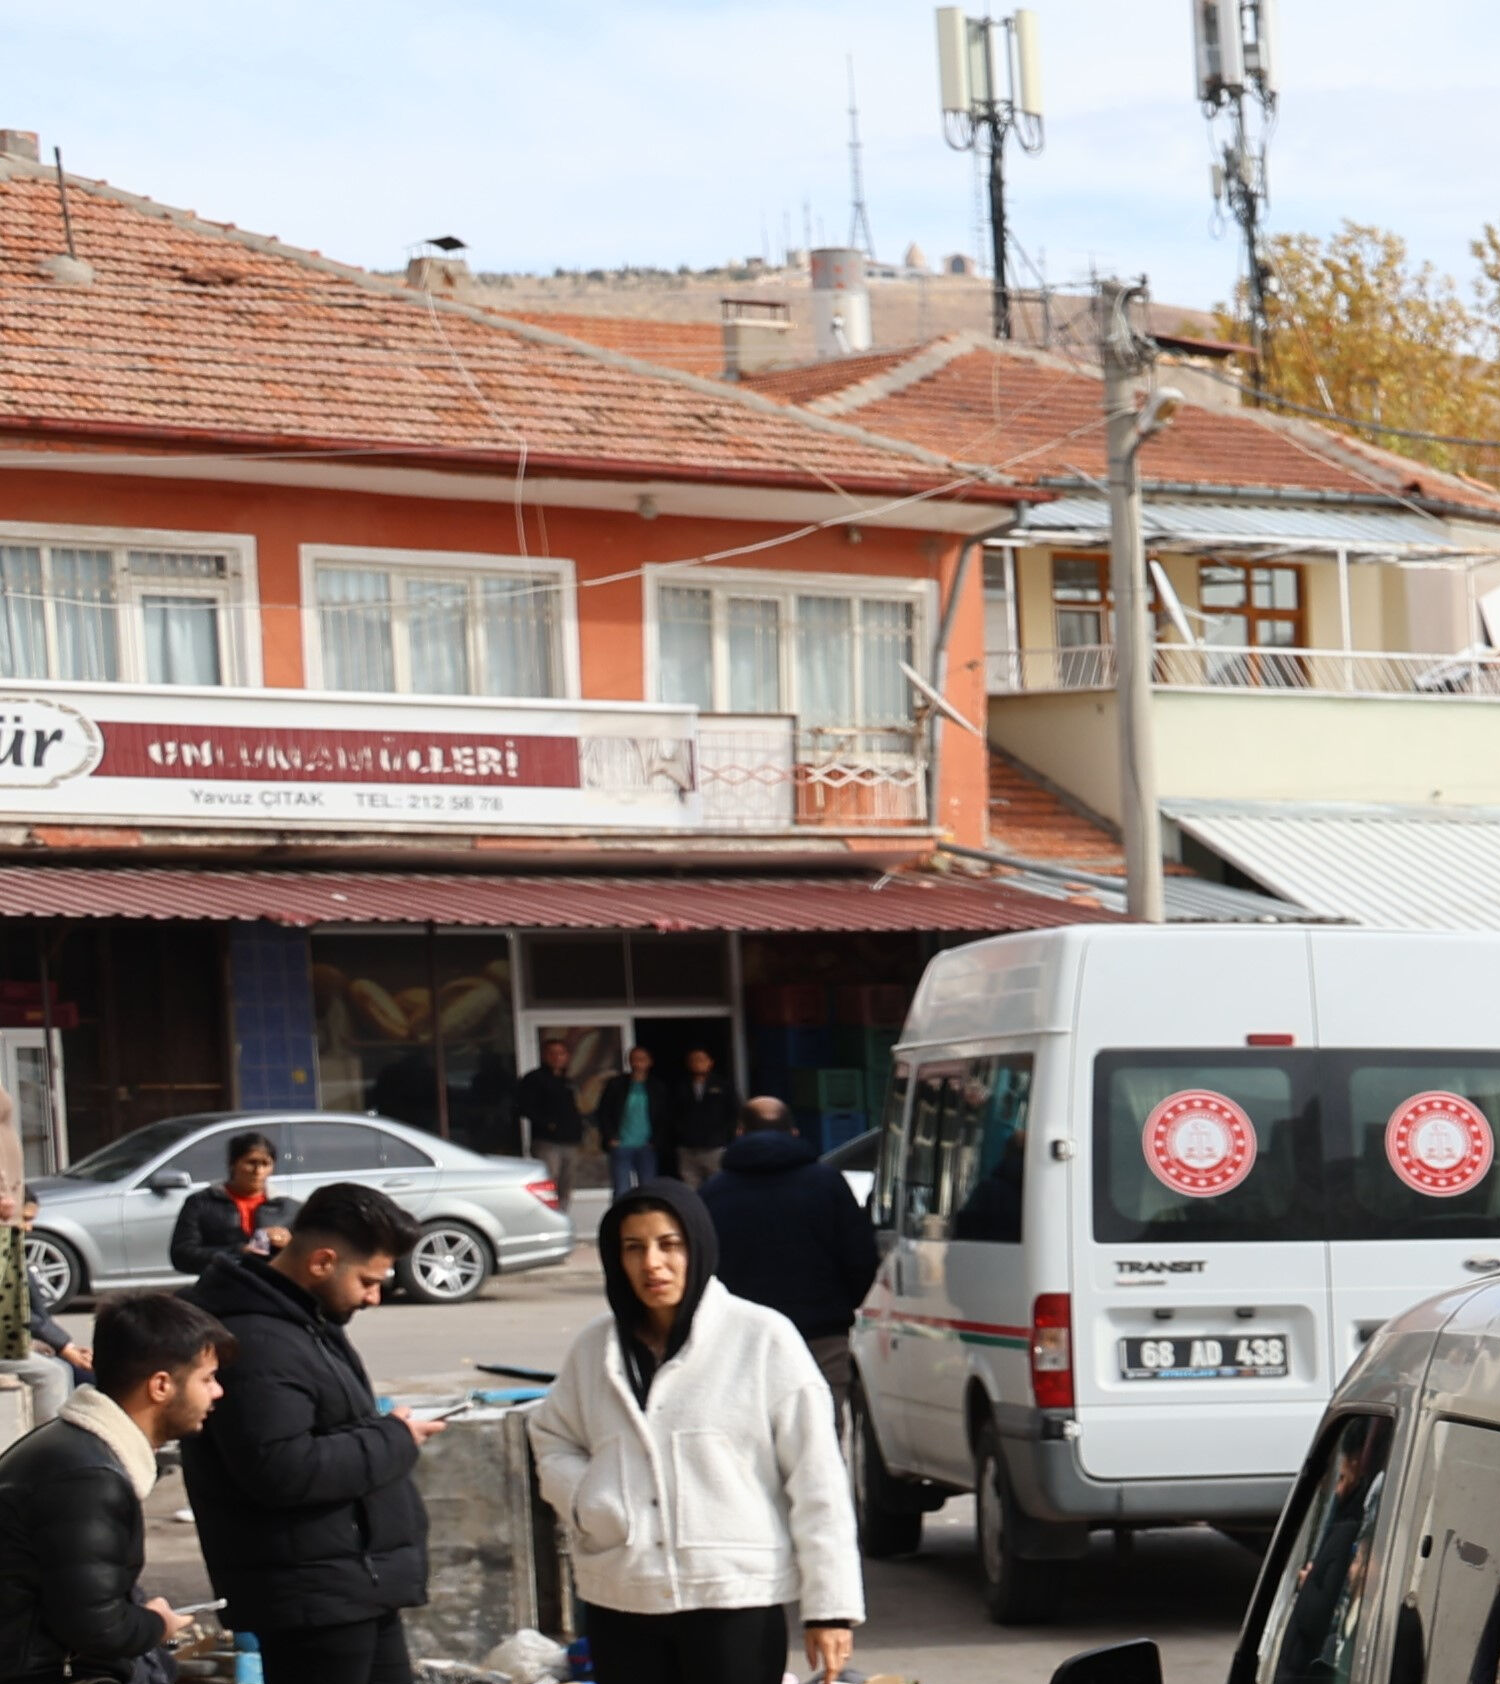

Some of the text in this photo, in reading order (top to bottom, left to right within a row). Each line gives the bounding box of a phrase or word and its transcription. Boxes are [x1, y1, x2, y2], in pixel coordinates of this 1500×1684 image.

[190, 788, 253, 805] Yavuz
[1114, 1261, 1207, 1274] TRANSIT
[1140, 1338, 1285, 1369] 68 AD 438
